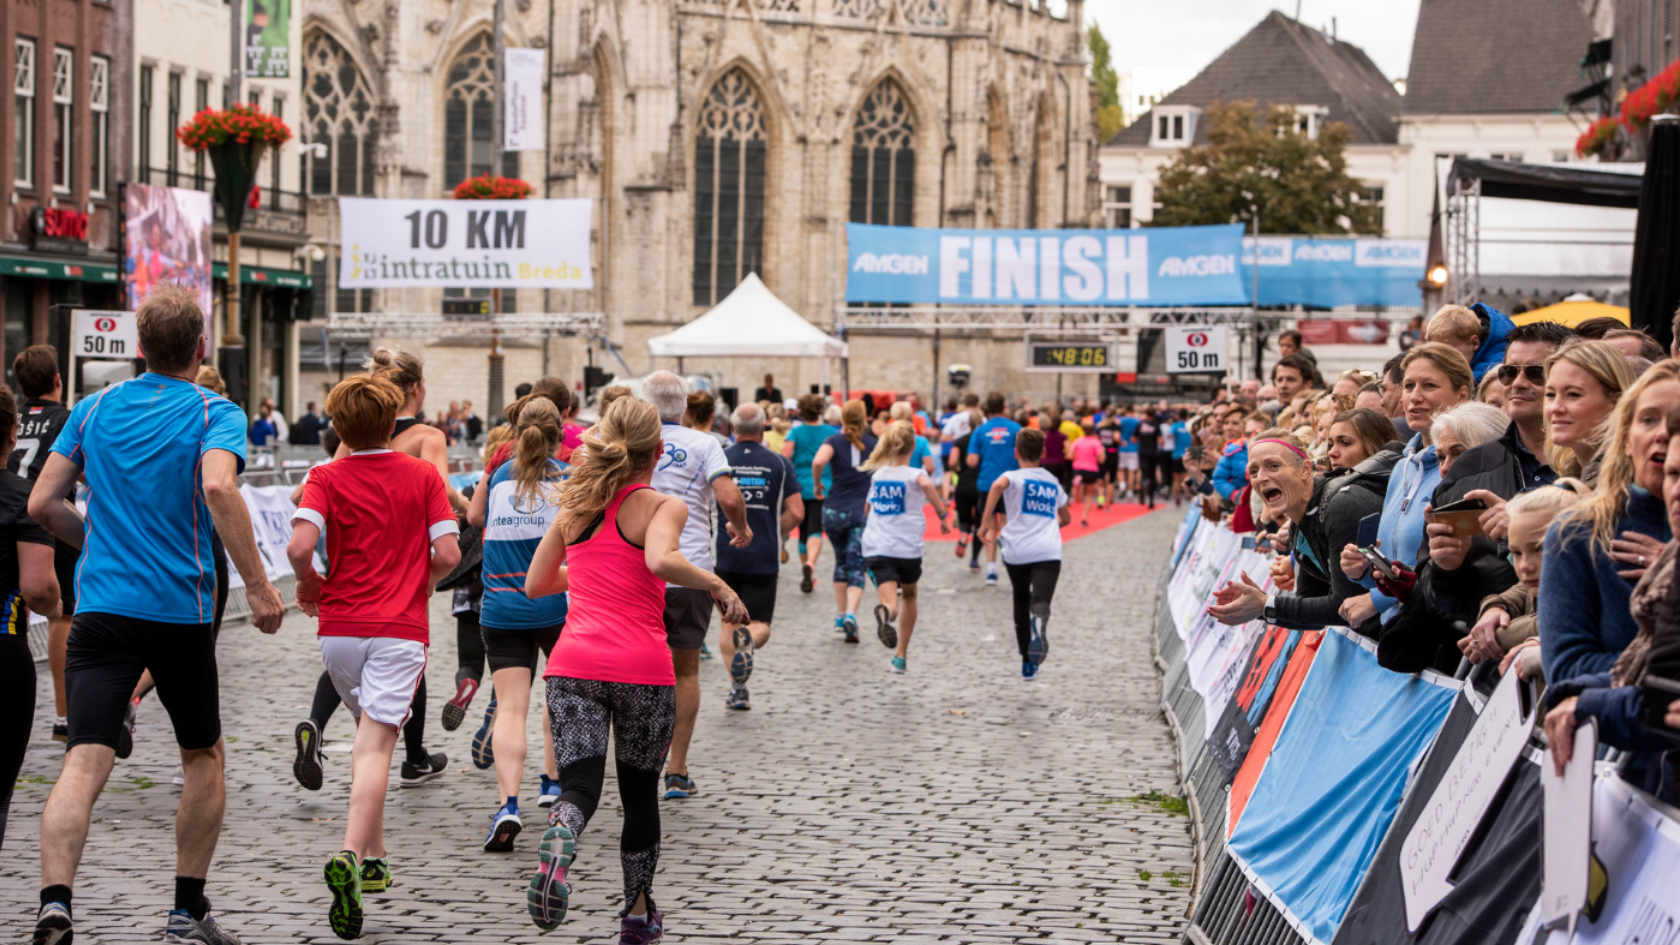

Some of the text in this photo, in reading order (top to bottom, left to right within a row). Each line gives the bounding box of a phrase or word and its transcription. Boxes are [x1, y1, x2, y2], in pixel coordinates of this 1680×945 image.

[405, 210, 526, 249] 10 KM
[381, 254, 582, 280] intratuin Breda
[853, 235, 1235, 301] AMGEN FINISH AMGEN
[84, 335, 125, 353] 50 m
[1178, 350, 1218, 368] 50 m
[1027, 483, 1056, 499] SAM
[1407, 802, 1443, 871] GOED
